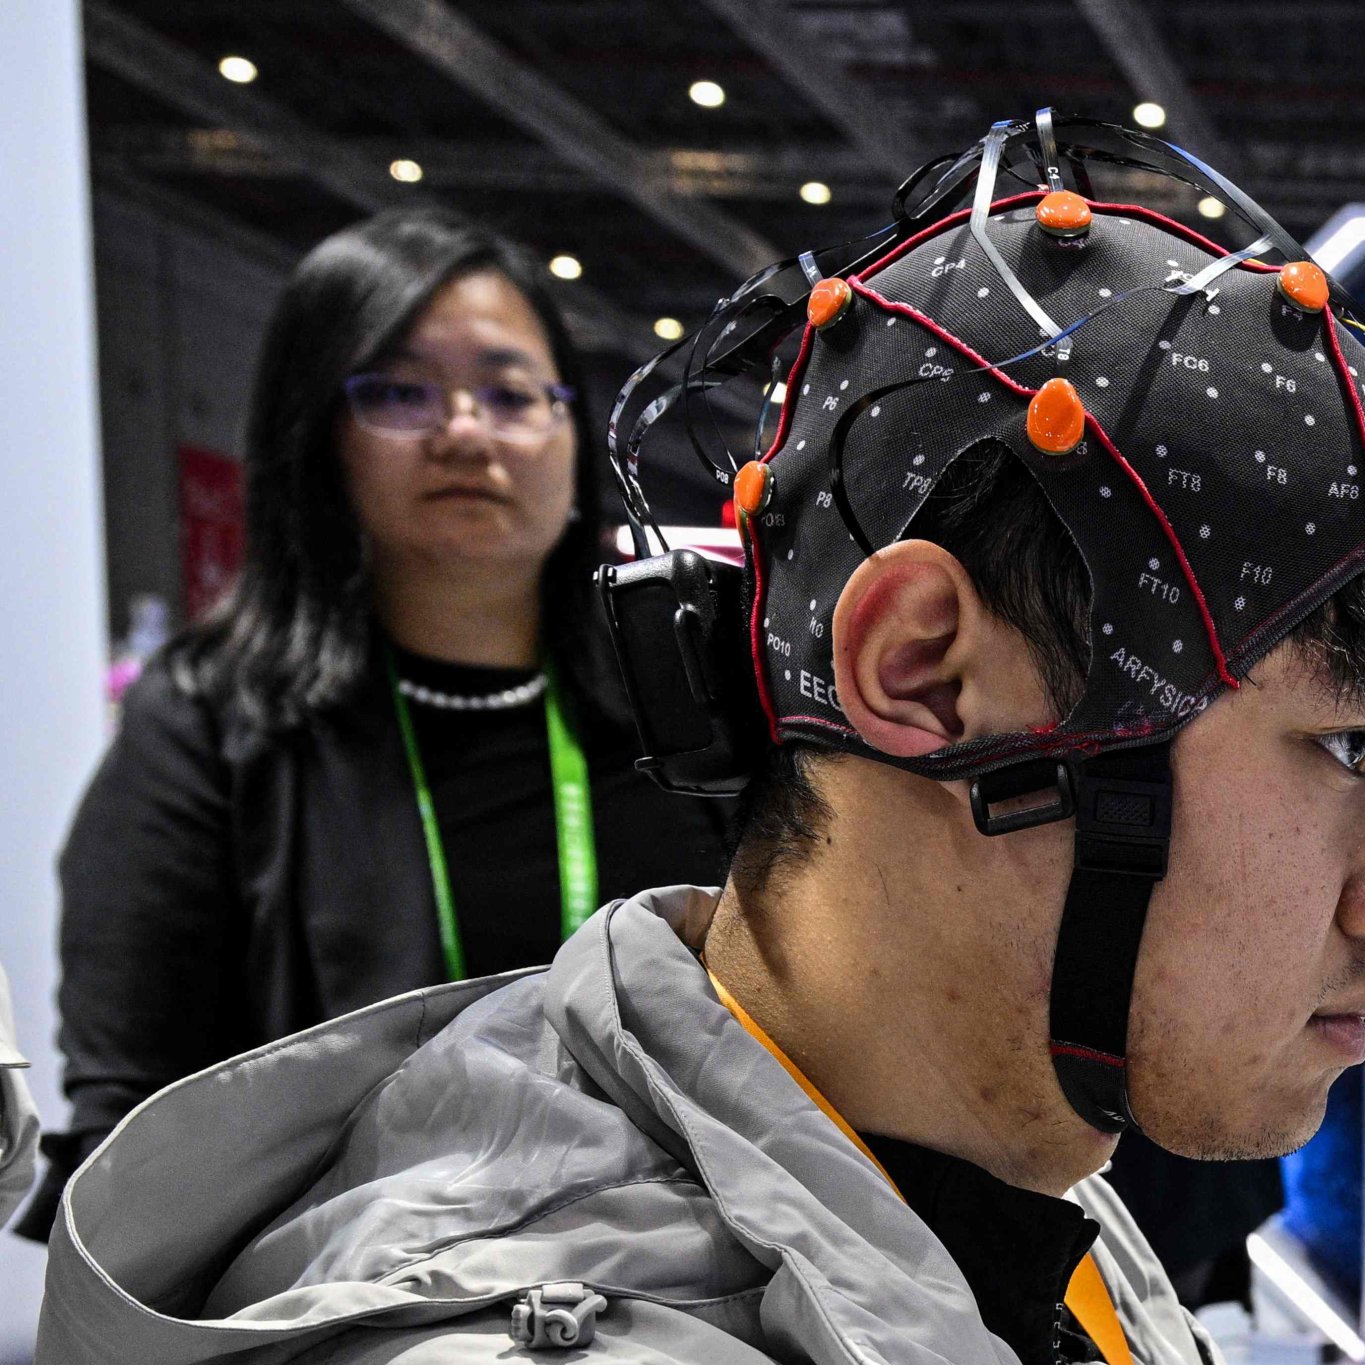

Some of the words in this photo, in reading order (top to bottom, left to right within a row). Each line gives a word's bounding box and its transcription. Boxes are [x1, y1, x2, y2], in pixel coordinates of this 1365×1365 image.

[931, 258, 966, 278] CP4
[1171, 353, 1210, 373] FC6
[822, 395, 839, 412] P6
[1266, 465, 1288, 485] F8
[816, 490, 834, 509] P8
[1137, 572, 1181, 605] FT10
[766, 632, 791, 657] PO10
